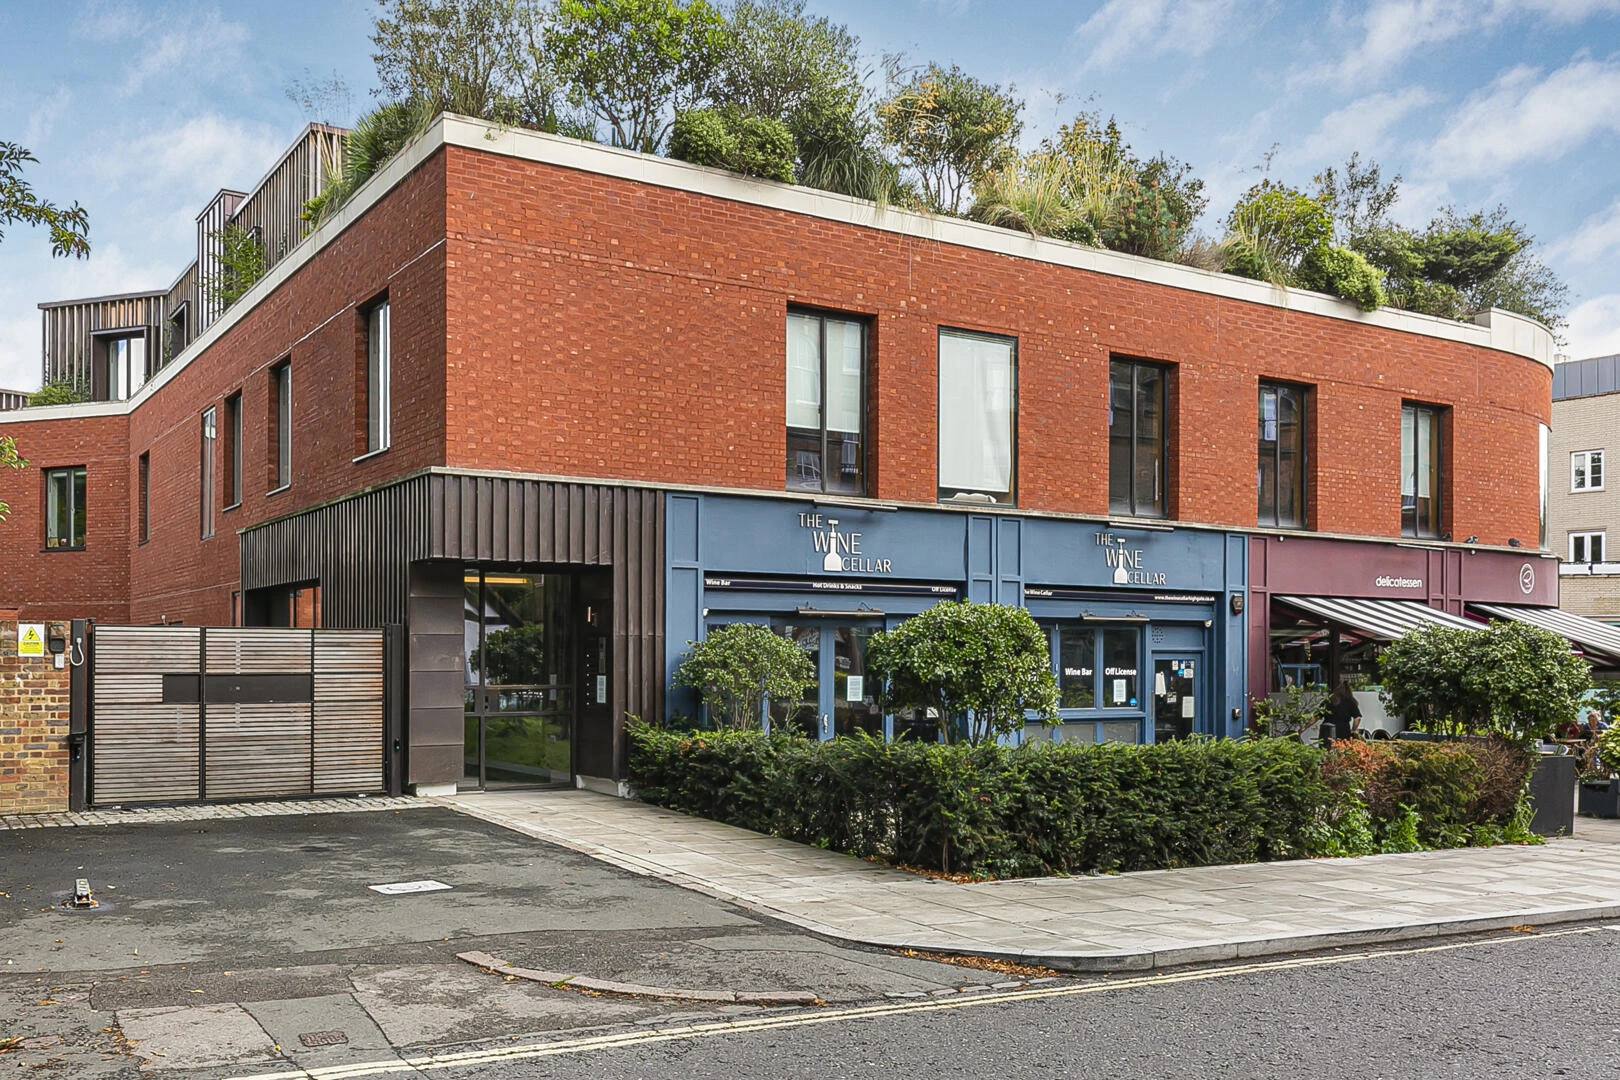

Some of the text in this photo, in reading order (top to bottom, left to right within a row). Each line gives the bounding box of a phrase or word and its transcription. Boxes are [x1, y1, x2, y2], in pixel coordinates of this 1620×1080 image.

[798, 512, 824, 528] THE
[813, 530, 862, 554] WINE
[1095, 532, 1114, 546] THE
[842, 557, 891, 573] CELLAR
[1105, 548, 1143, 569] WINE
[705, 578, 720, 586] Wine
[1127, 571, 1166, 585] CELLAR
[1375, 576, 1422, 588] delicatessen
[1065, 667, 1093, 676] Wine Bar
[1105, 667, 1137, 676] Off License
